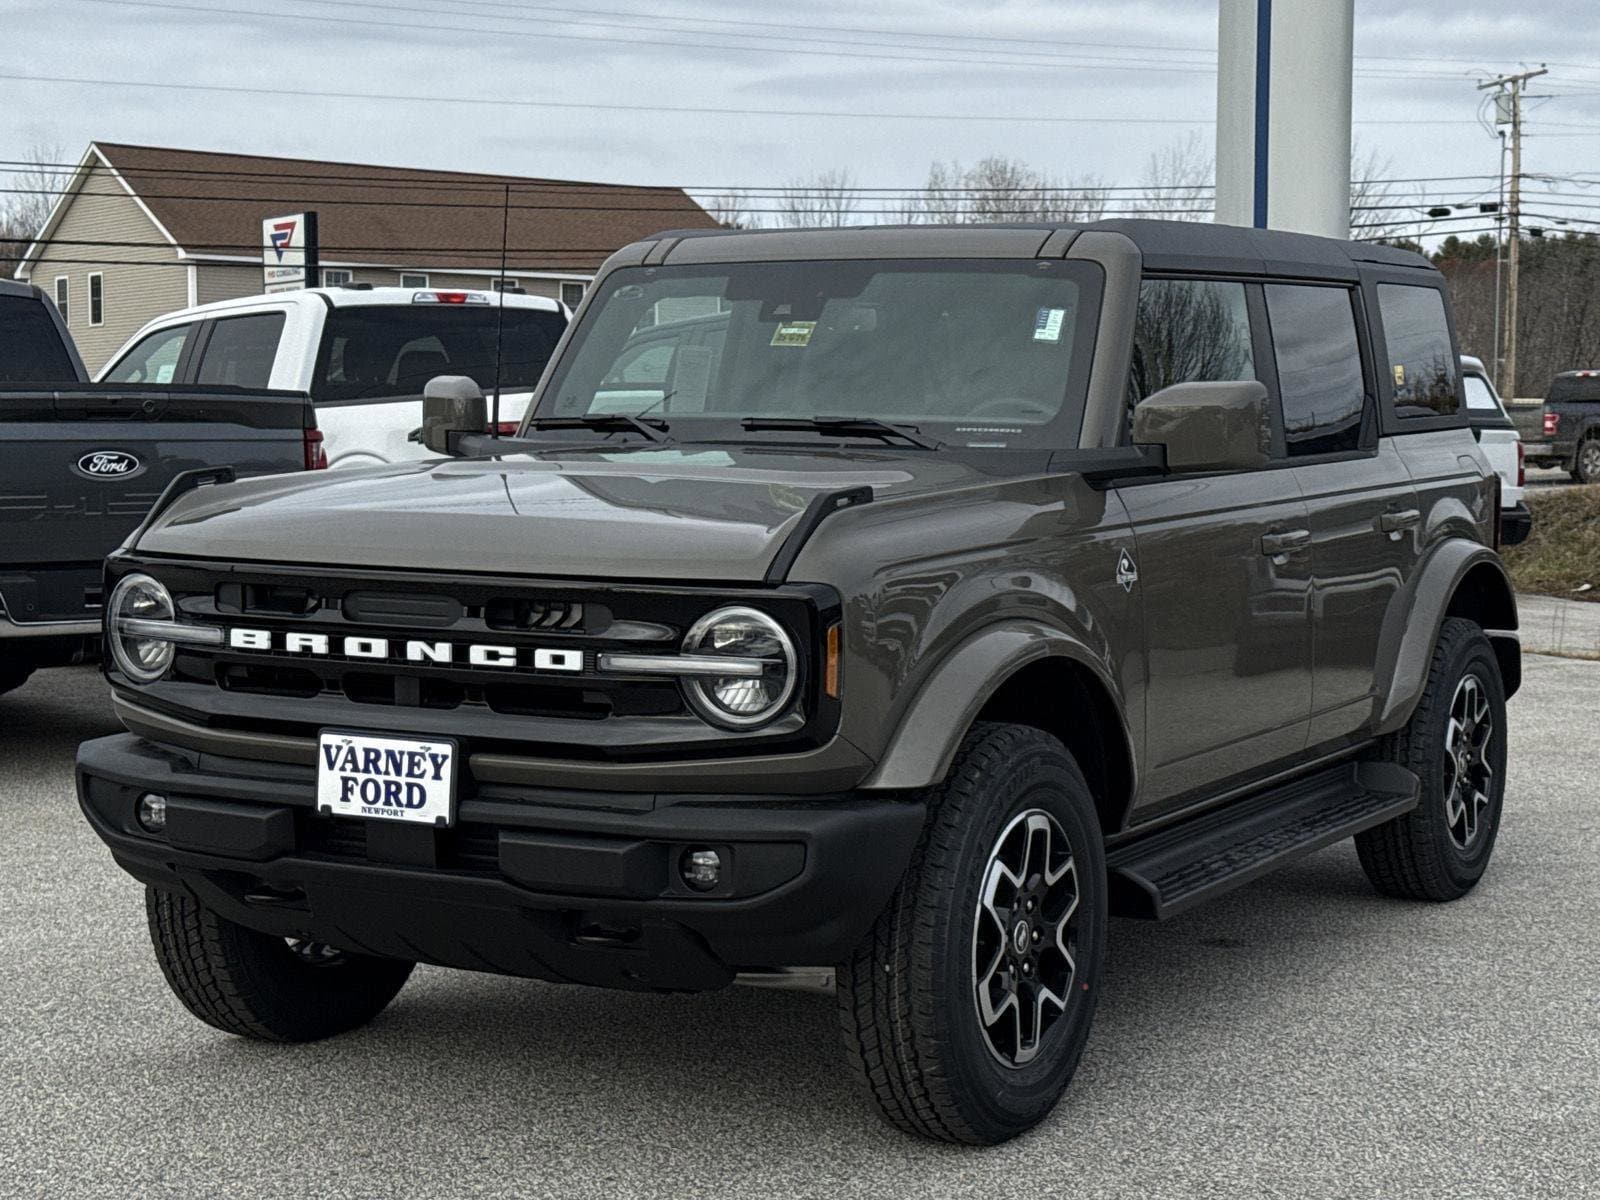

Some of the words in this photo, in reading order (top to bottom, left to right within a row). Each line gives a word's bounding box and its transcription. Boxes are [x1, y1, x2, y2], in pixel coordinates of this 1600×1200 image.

[89, 454, 129, 472] Ford
[230, 627, 584, 671] BRONCO
[322, 743, 449, 781] VARNEY
[340, 775, 427, 809] FORD
[361, 806, 405, 817] NEWPORT
